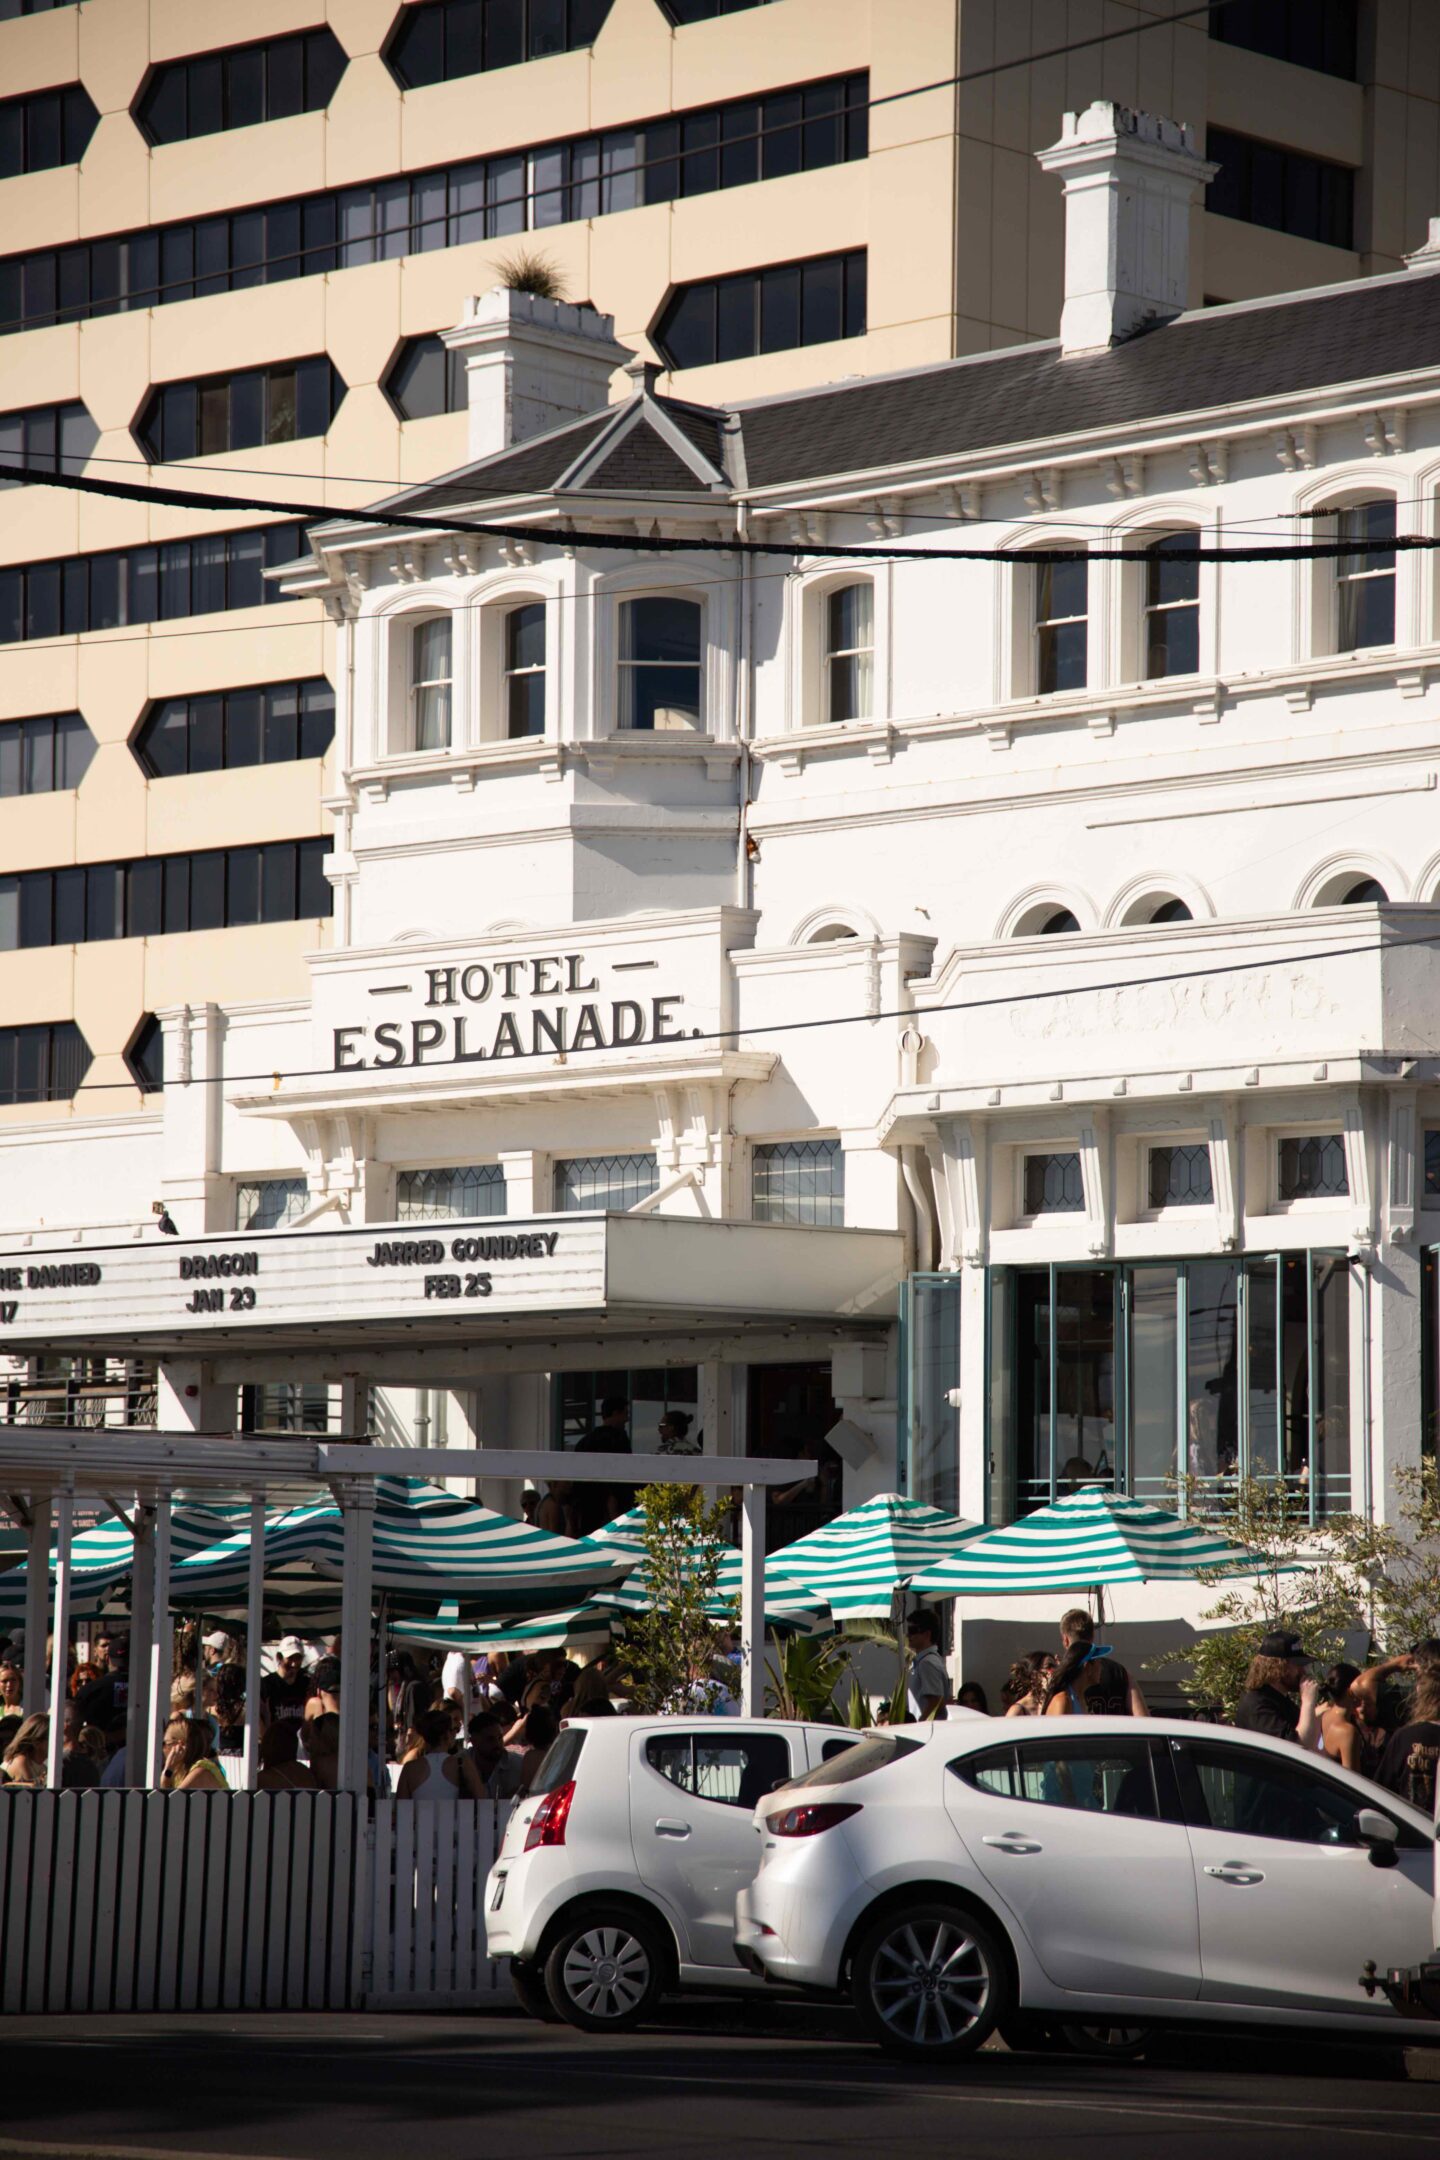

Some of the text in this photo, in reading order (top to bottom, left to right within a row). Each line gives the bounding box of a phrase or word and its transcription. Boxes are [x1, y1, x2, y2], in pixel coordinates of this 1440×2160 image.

[424, 954, 598, 1008] HOTEL
[366, 1232, 559, 1267] JARRED GOUNDREY
[27, 1262, 102, 1290] DAMNED
[179, 1252, 258, 1280] DRAGON
[424, 1272, 493, 1299] FEB 25
[185, 1287, 256, 1313] JAN 23
